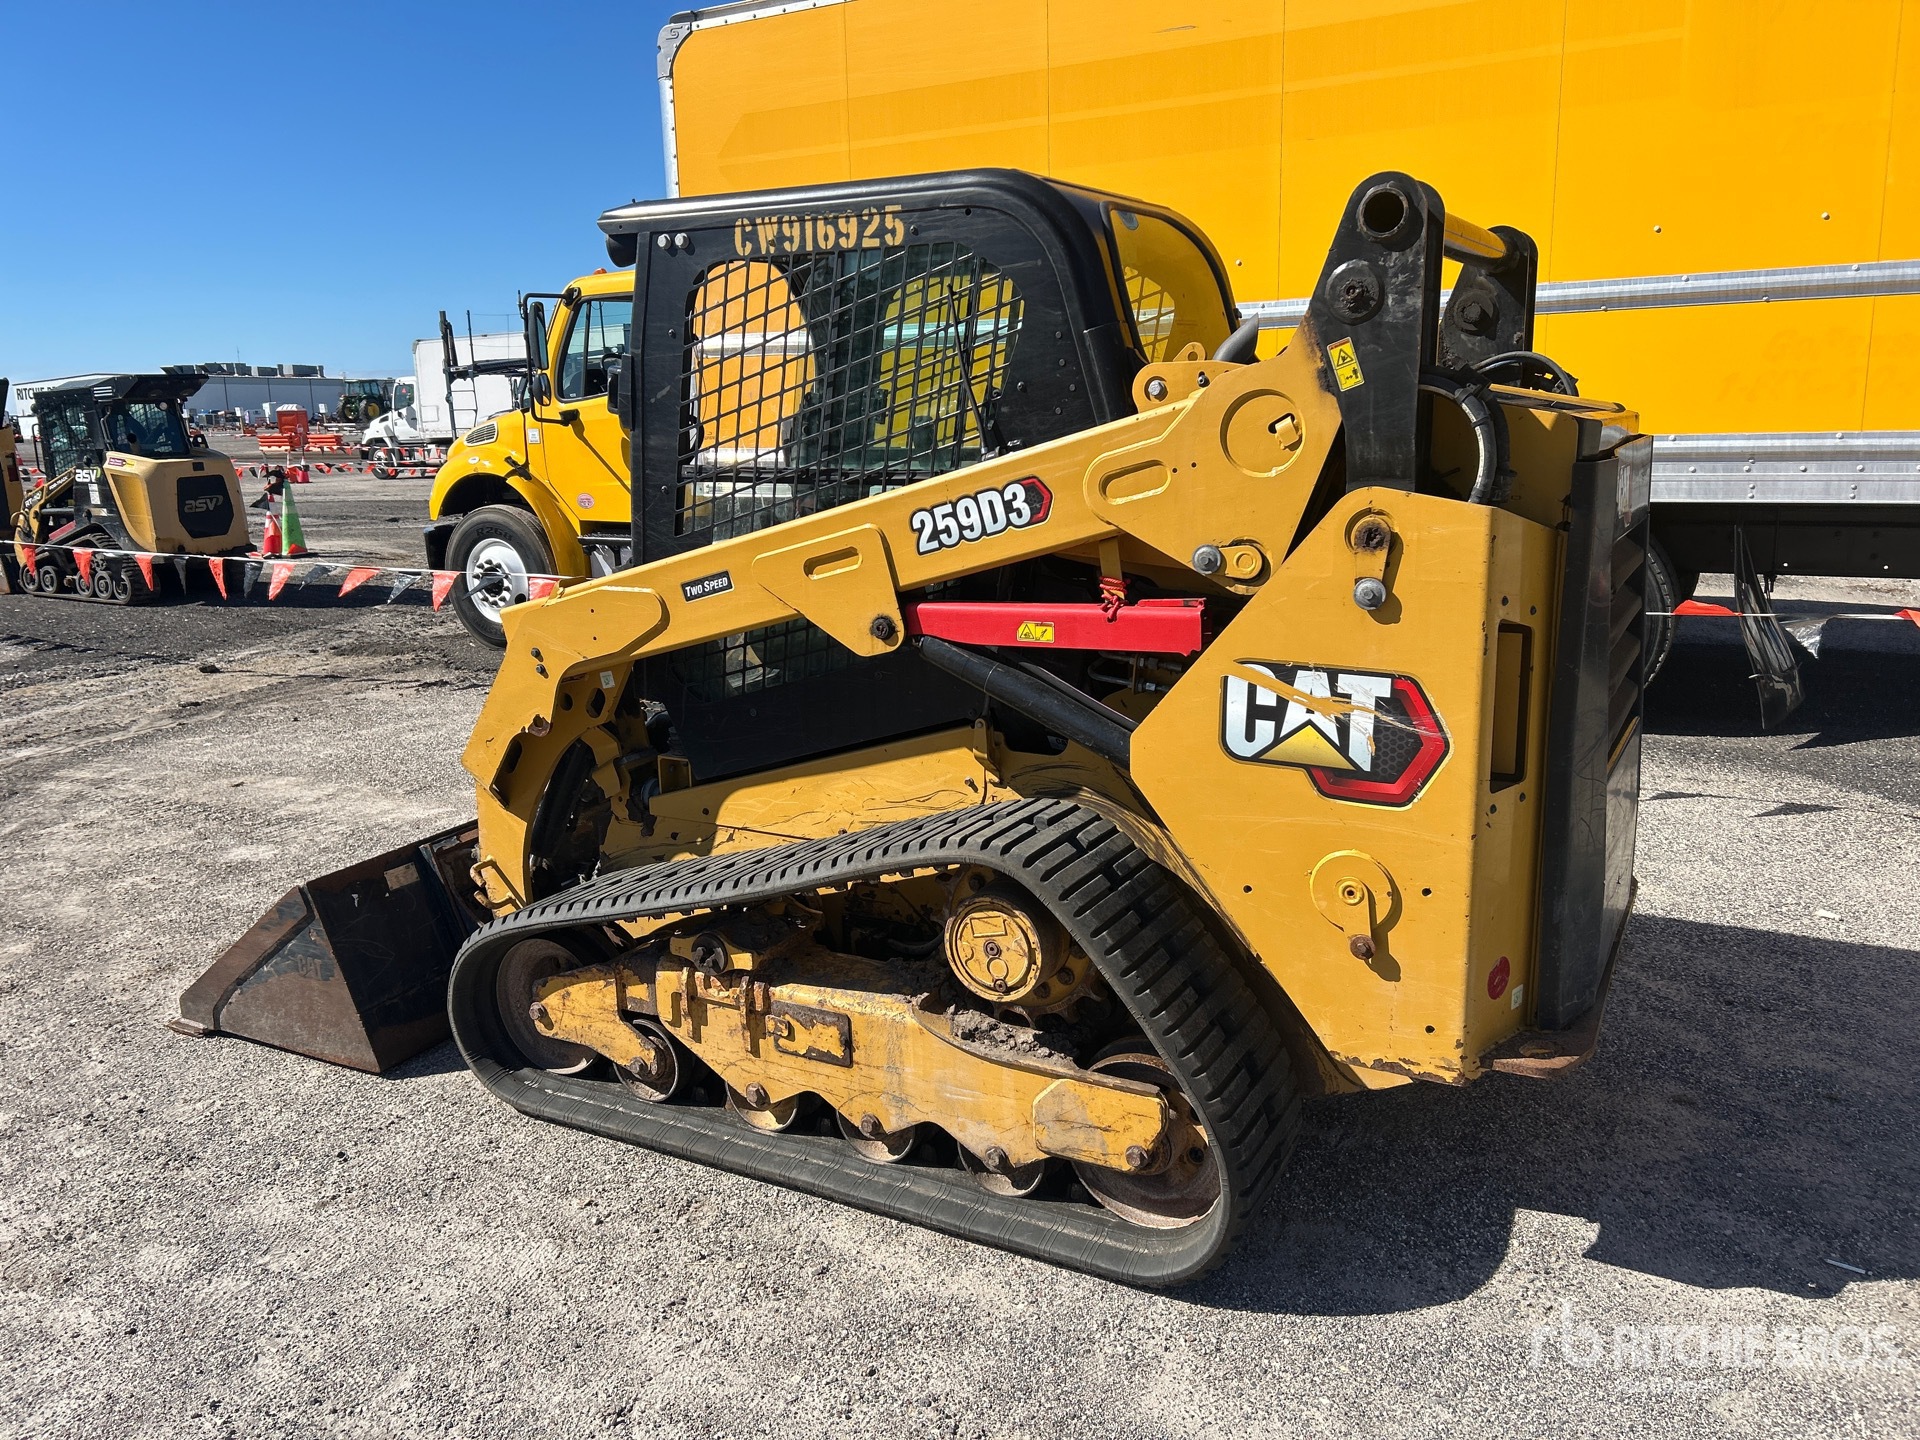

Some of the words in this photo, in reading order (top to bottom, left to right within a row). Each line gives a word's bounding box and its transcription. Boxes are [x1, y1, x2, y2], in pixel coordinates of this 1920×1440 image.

[734, 204, 905, 256] CW916925
[912, 483, 1031, 553] 259D3
[1226, 663, 1392, 772] CAT
